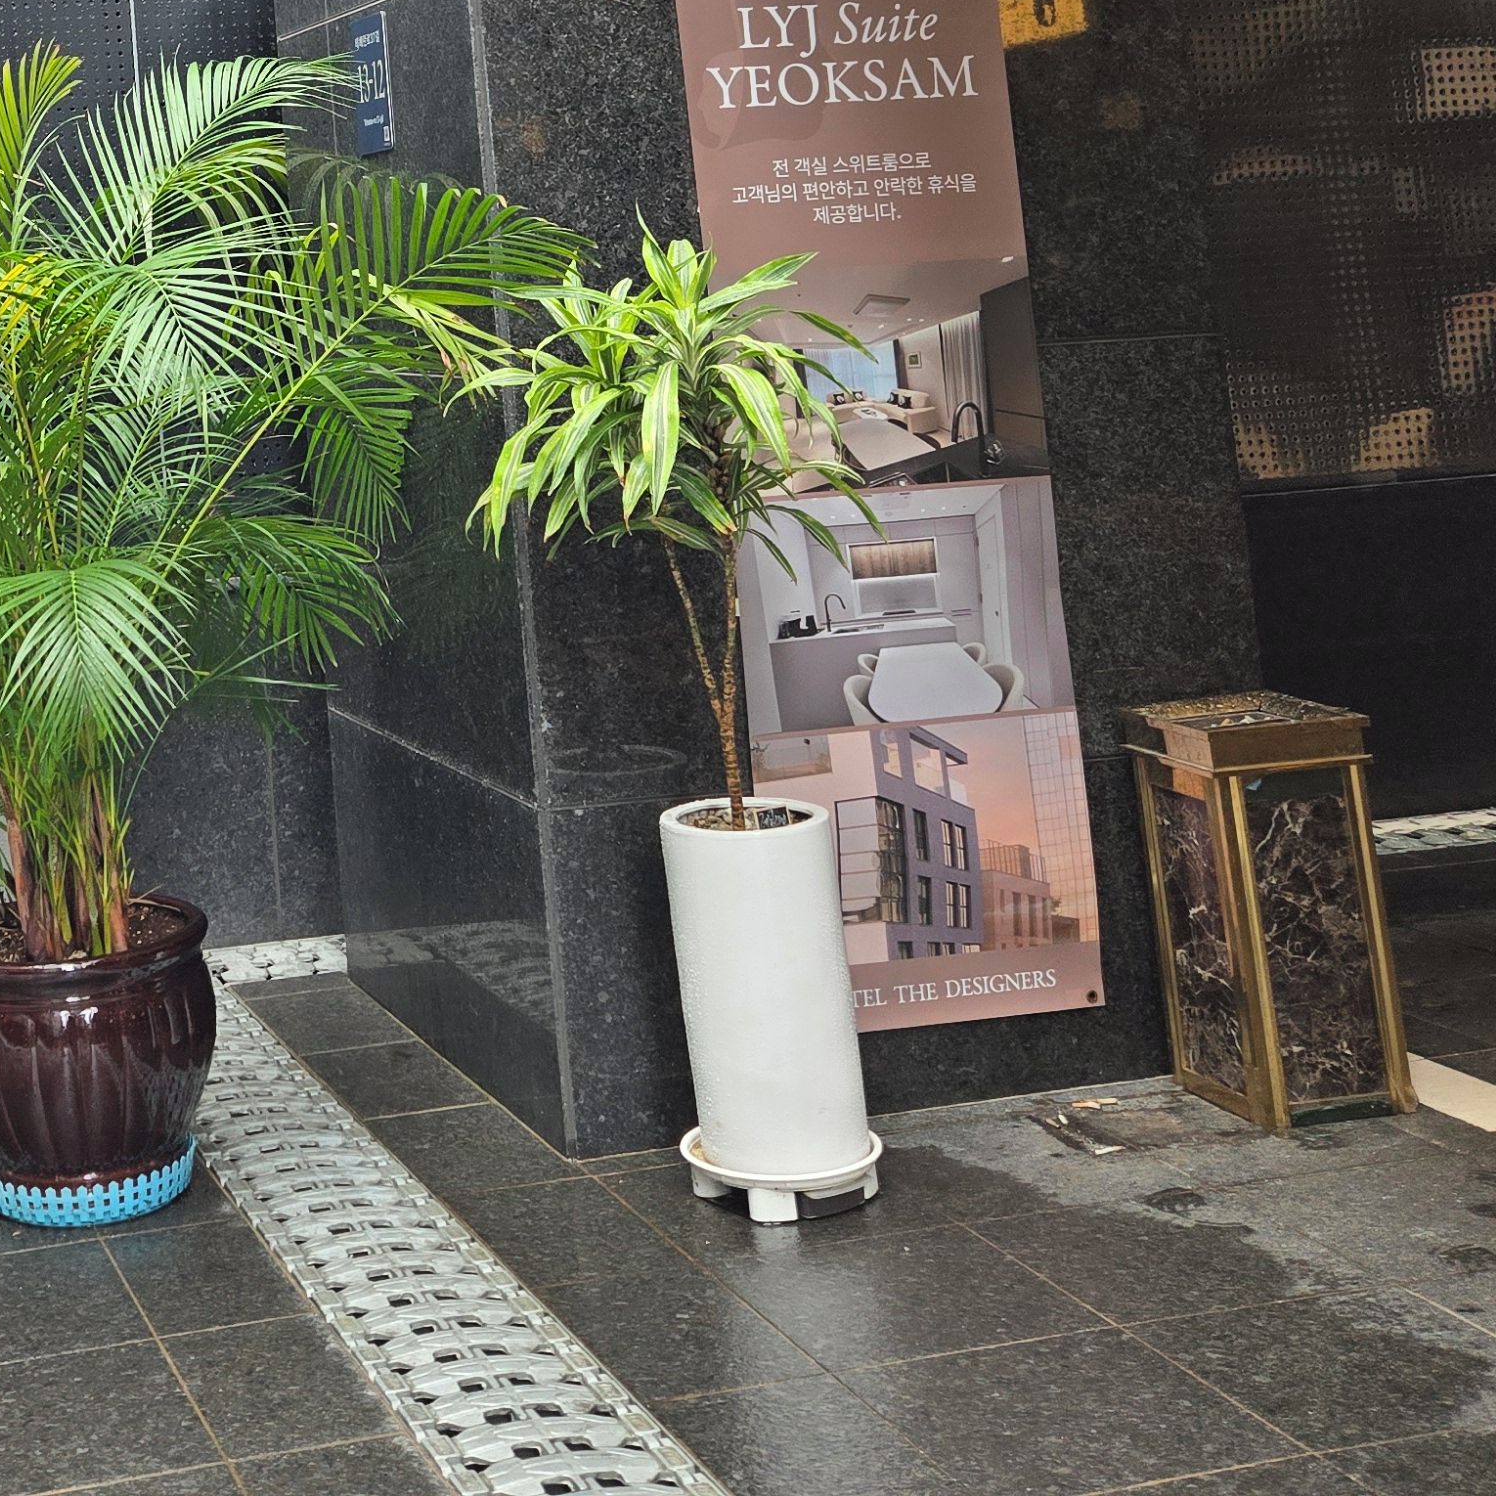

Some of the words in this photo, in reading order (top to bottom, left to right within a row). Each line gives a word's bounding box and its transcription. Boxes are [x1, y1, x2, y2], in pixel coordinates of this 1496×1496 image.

[737, 4, 818, 58] LYJ
[834, 2, 938, 44] Suite
[357, 59, 386, 104] 13-12
[705, 55, 979, 109] YEOKSAM
[772, 159, 790, 179] 전
[794, 156, 828, 176] 객실
[832, 152, 932, 174] 스위트룸으로
[732, 183, 797, 204] 고객님의
[802, 179, 869, 202] 편안하고
[873, 176, 923, 196] 안락한
[927, 173, 977, 194] 휴식을
[812, 201, 902, 225] 제공합니다.
[893, 982, 938, 1004] THE
[945, 968, 1057, 998] DESIGNERS
